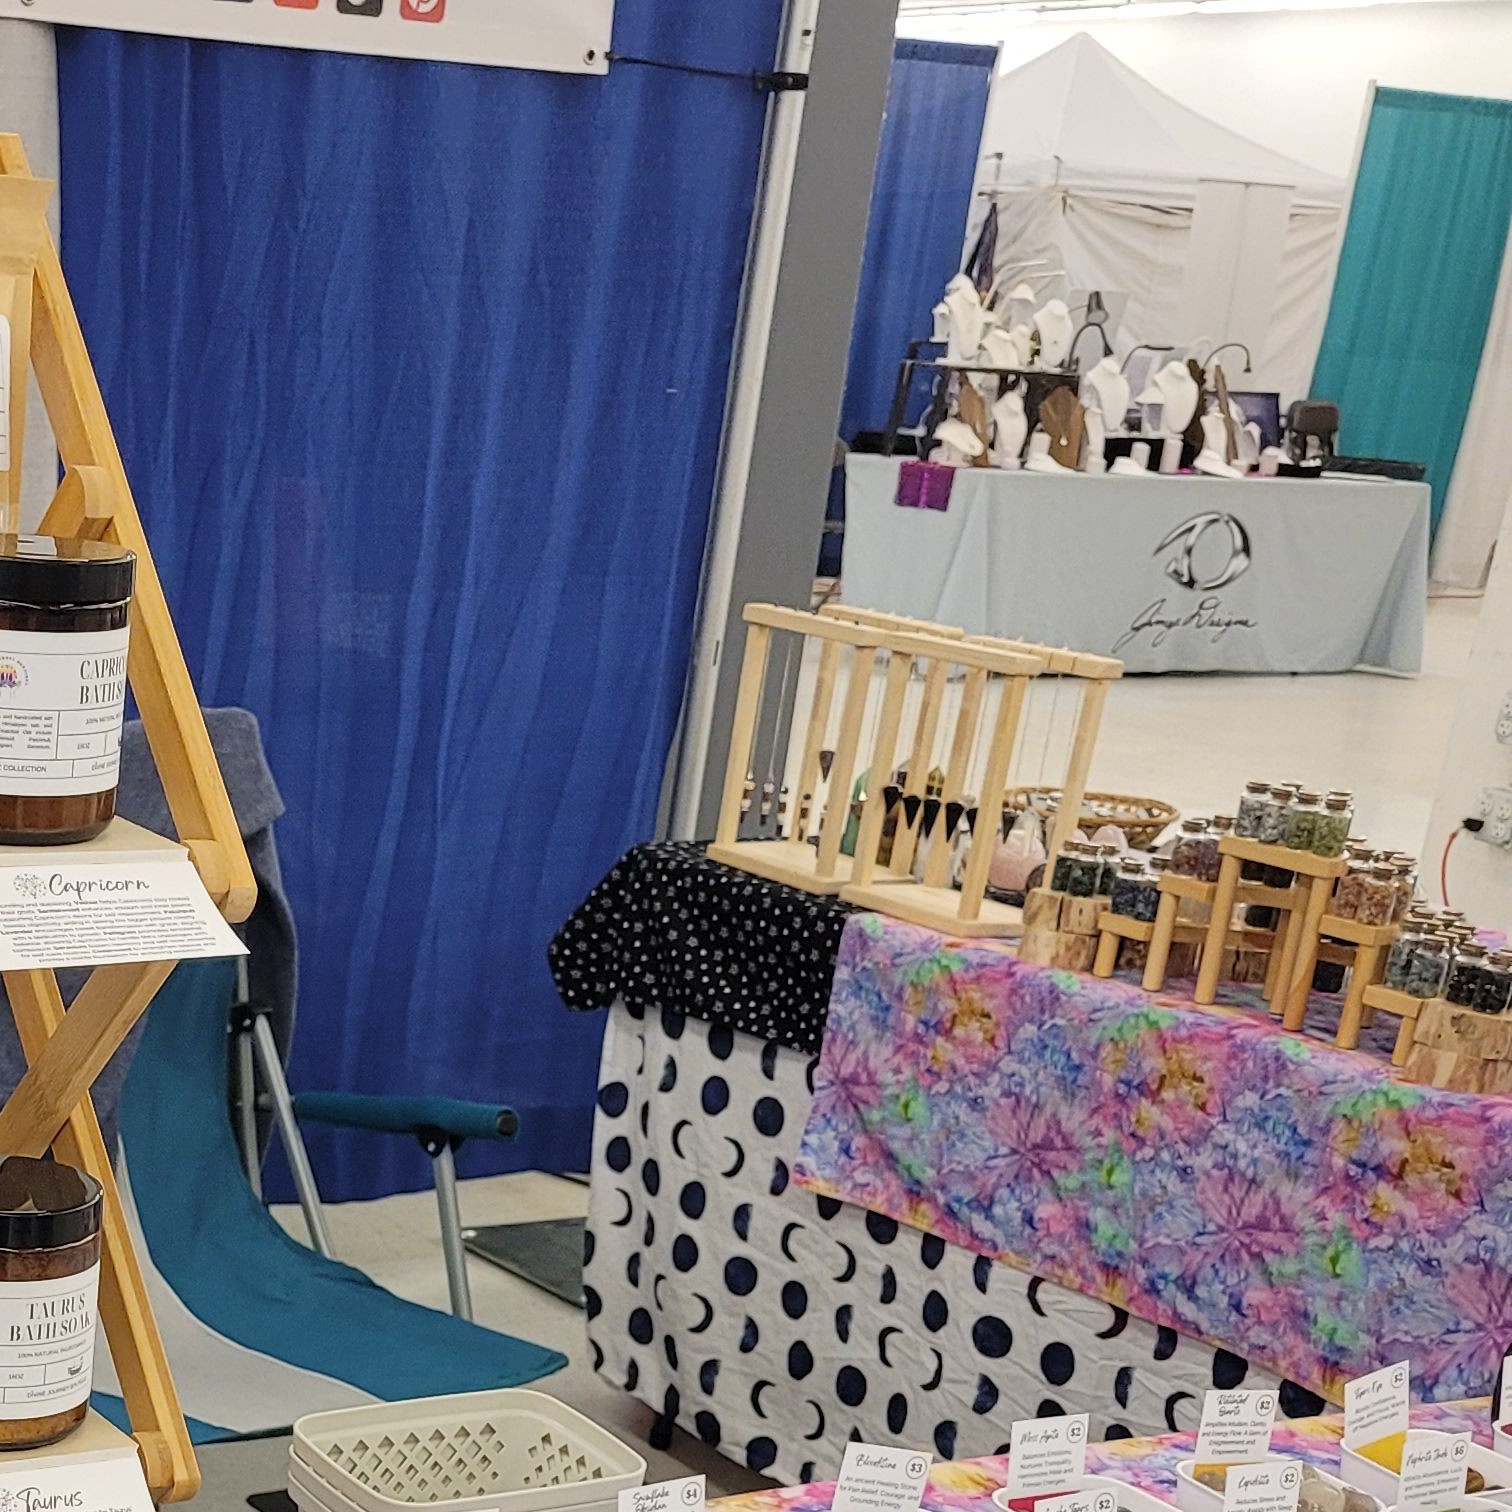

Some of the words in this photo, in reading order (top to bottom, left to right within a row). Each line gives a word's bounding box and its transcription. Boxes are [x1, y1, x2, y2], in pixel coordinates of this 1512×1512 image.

[79, 685, 114, 705] BATH
[3, 764, 47, 773] COLLECTION
[49, 873, 150, 900] Capricorn
[27, 1293, 85, 1320] TAURUS
[9, 1323, 57, 1342] BATH
[60, 1313, 90, 1336] SOAK
[910, 1463, 922, 1472] $3
[1283, 1473, 1295, 1483] $2
[1099, 1499, 1111, 1510] $2
